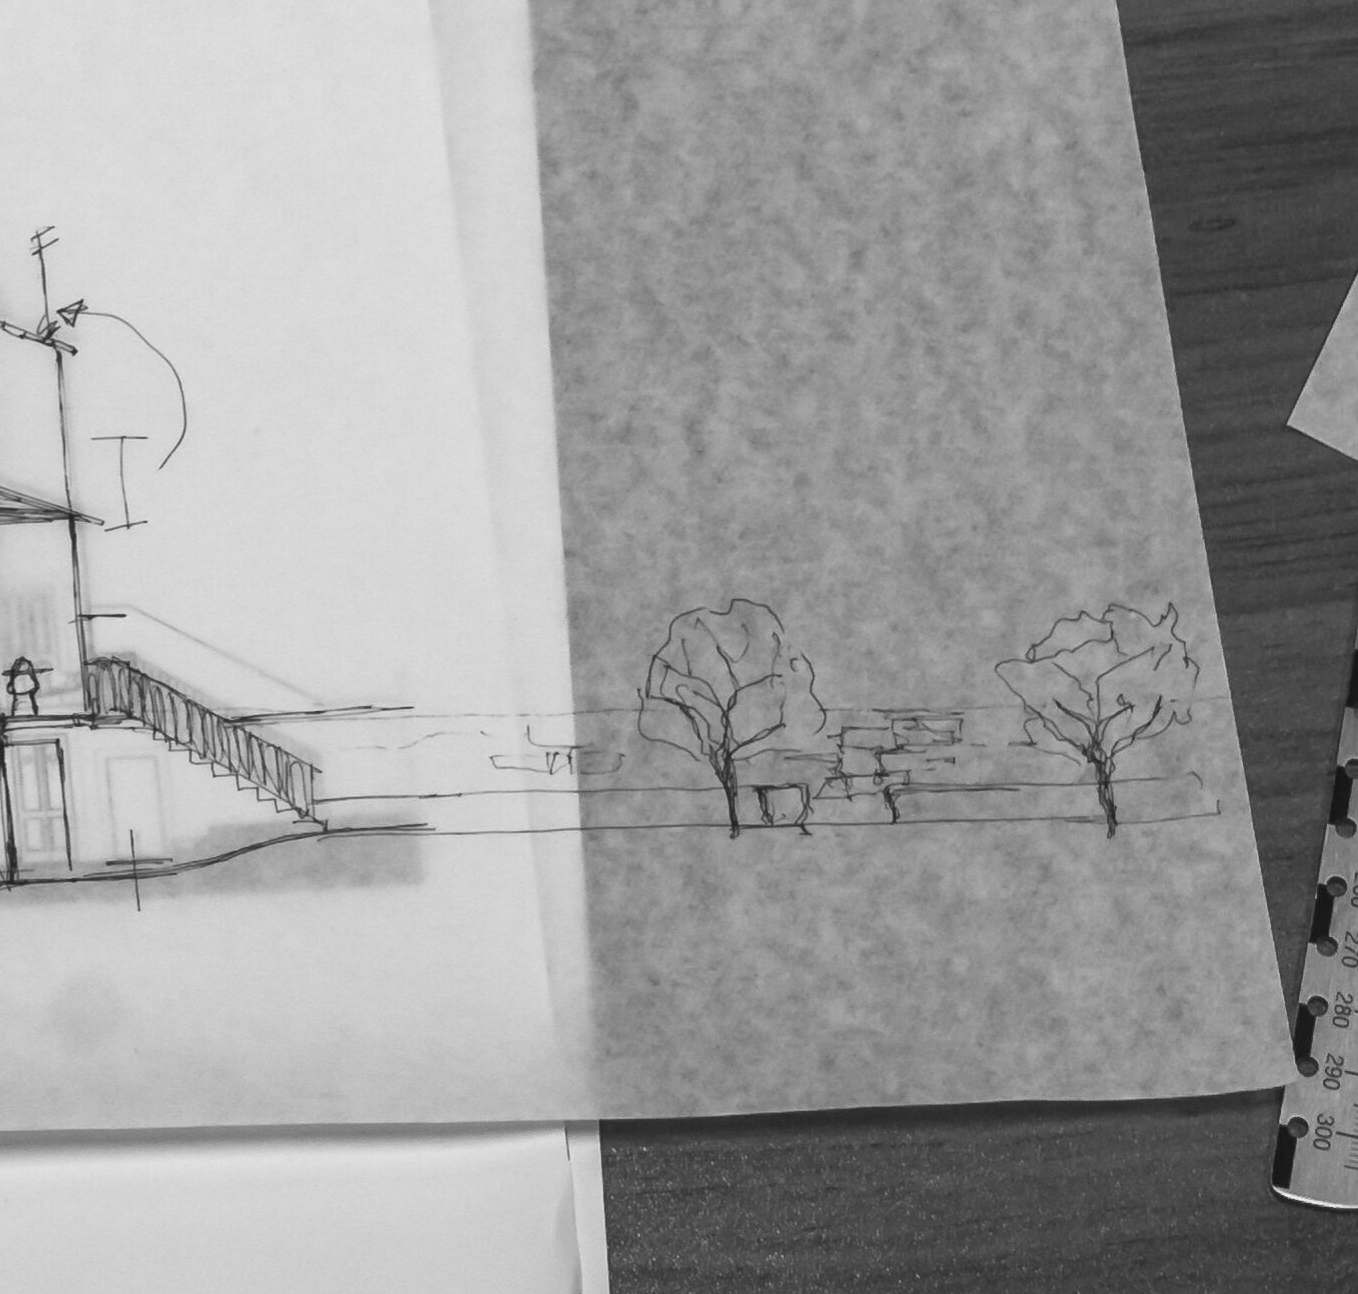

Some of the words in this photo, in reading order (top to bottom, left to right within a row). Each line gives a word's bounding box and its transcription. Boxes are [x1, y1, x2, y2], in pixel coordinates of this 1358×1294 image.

[1331, 990, 1354, 1031] 280
[1321, 1052, 1346, 1092] 290
[1311, 1112, 1336, 1153] 300
